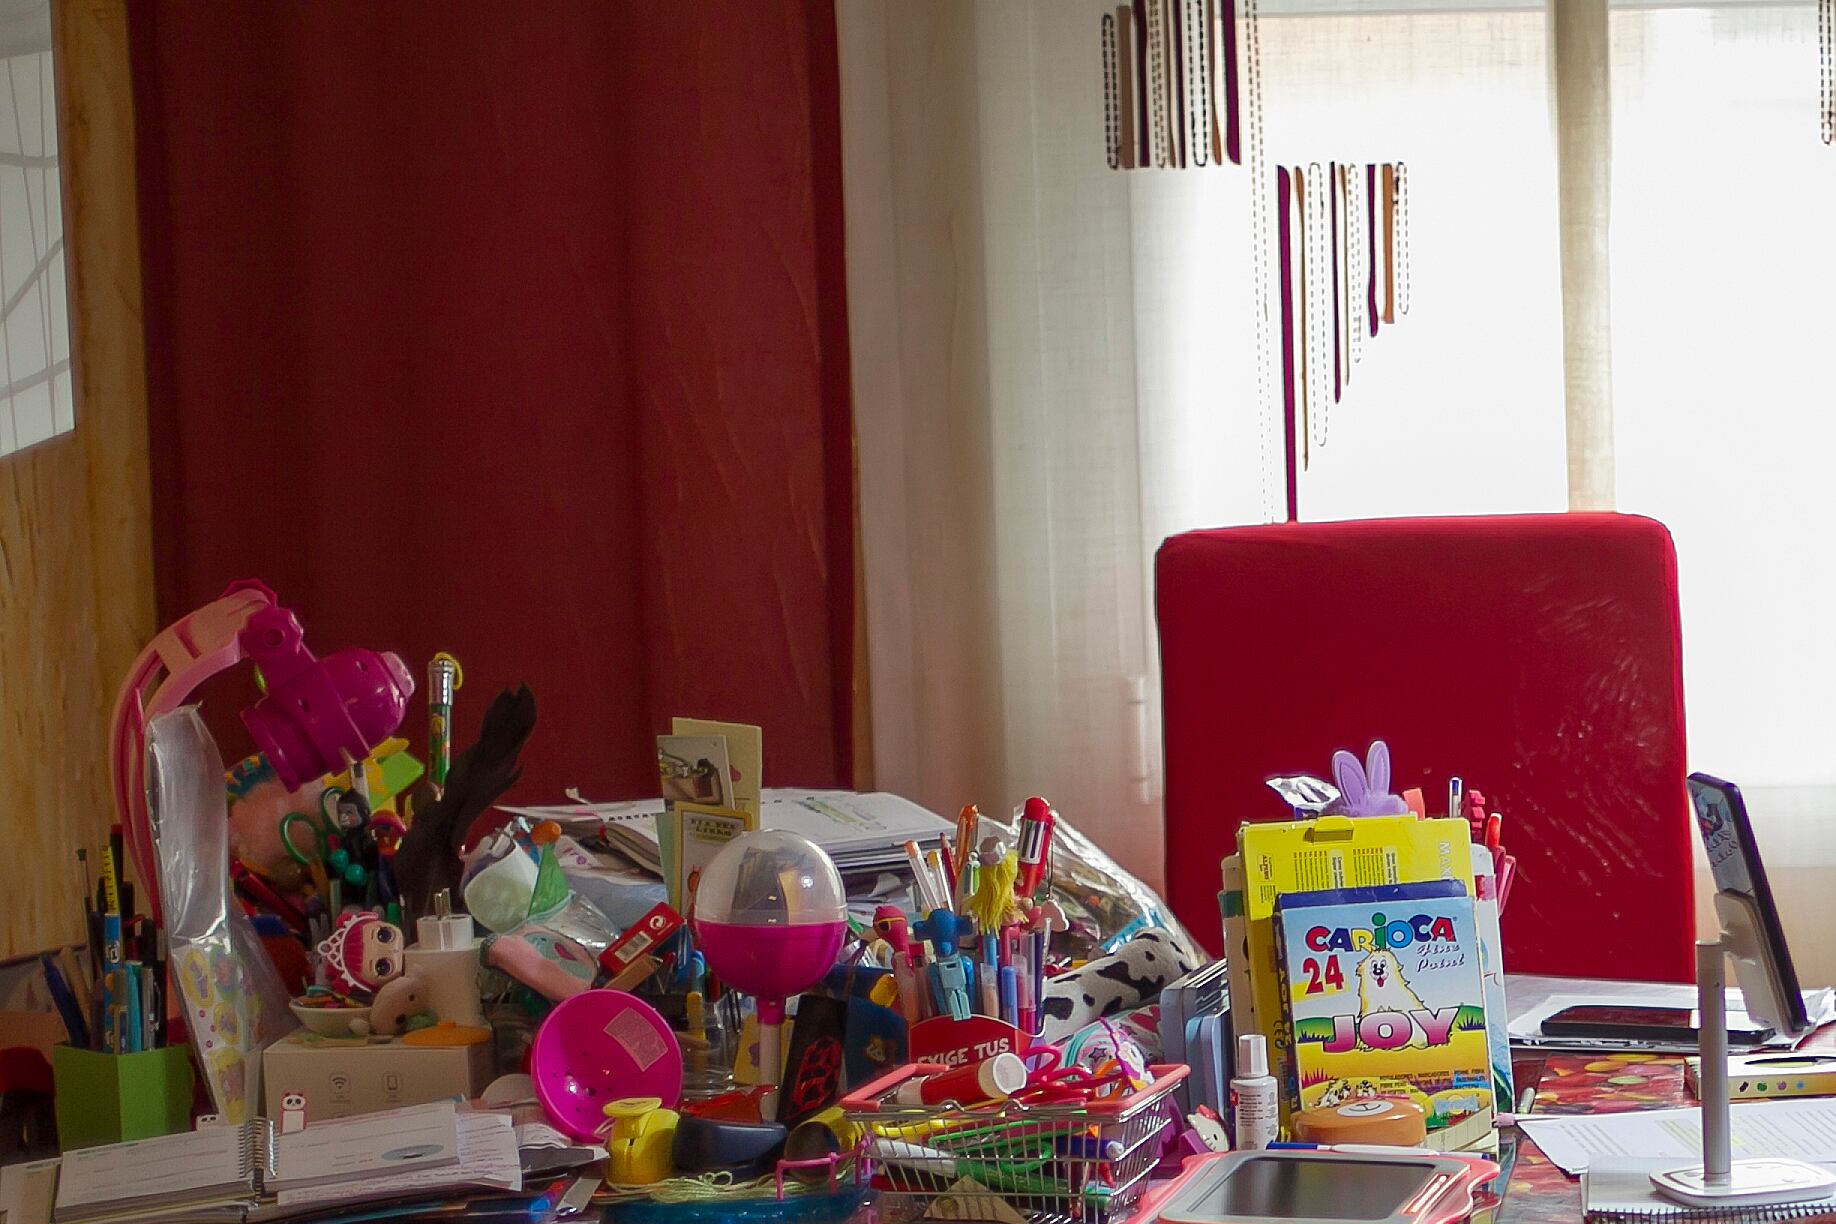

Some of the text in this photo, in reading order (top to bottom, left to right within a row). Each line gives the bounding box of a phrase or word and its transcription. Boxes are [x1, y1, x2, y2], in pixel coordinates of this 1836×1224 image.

[1304, 910, 1456, 953] CARIOCA
[1302, 954, 1345, 995] 24
[973, 1037, 1010, 1059] TUS
[1322, 1006, 1460, 1054] JOY
